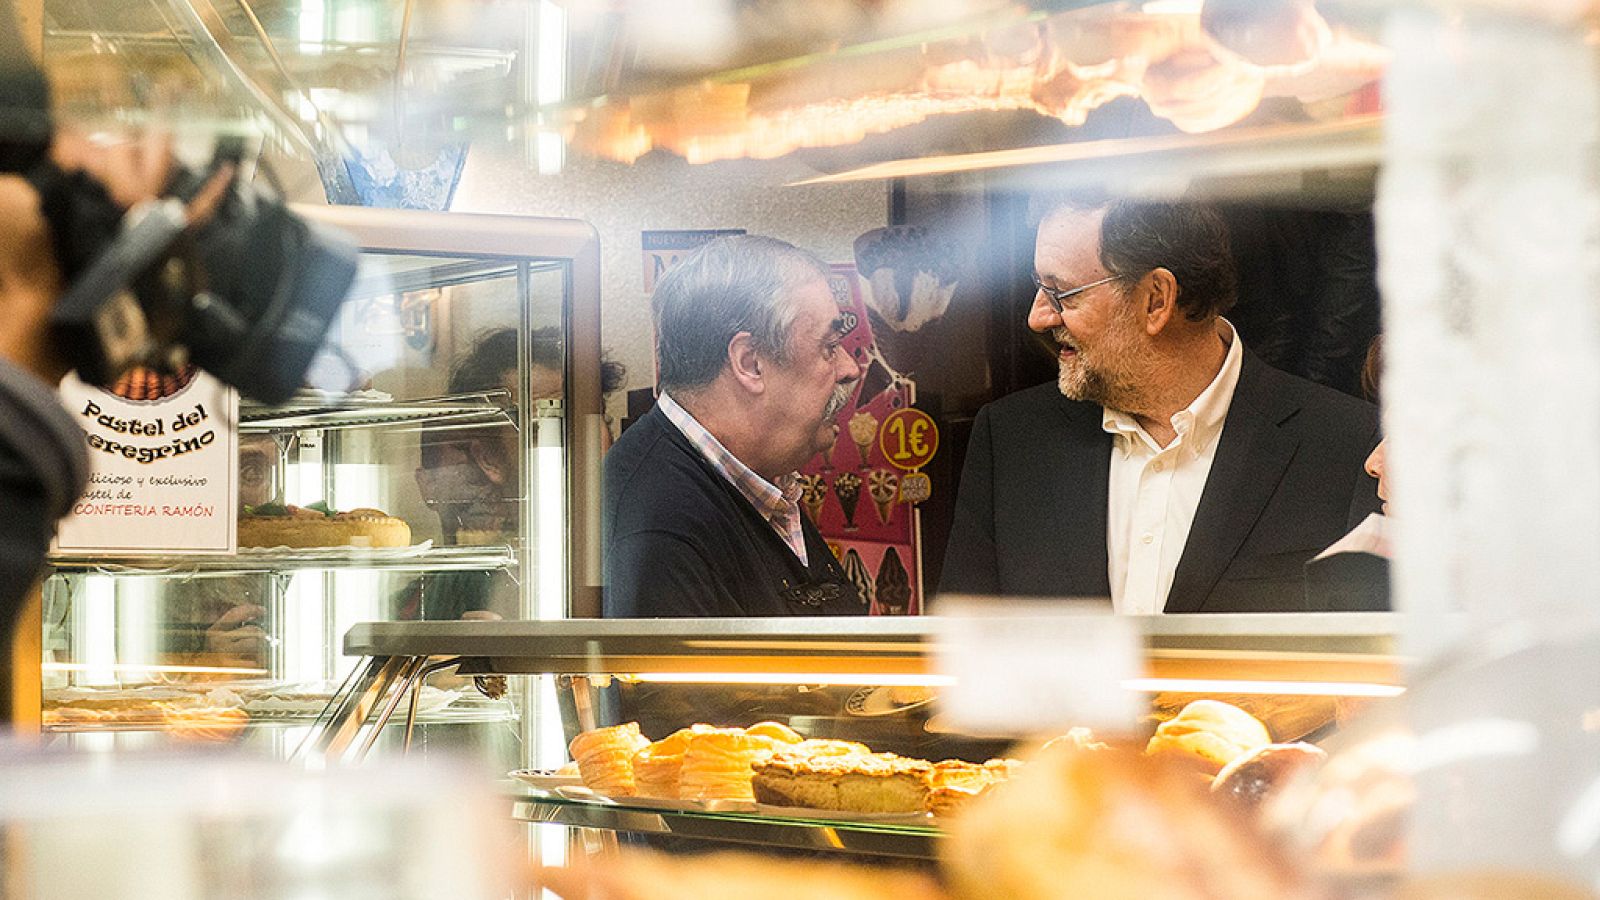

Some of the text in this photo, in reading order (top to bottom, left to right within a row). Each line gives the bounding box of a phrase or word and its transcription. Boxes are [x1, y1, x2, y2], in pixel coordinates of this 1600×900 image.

[81, 400, 208, 436] Pastel del
[86, 430, 215, 464] eregrino
[889, 416, 928, 460] 1€
[89, 472, 208, 487] licioso y exclusivo
[82, 488, 132, 501] astel de
[74, 502, 214, 518] CONFITERIA RAMÓN
